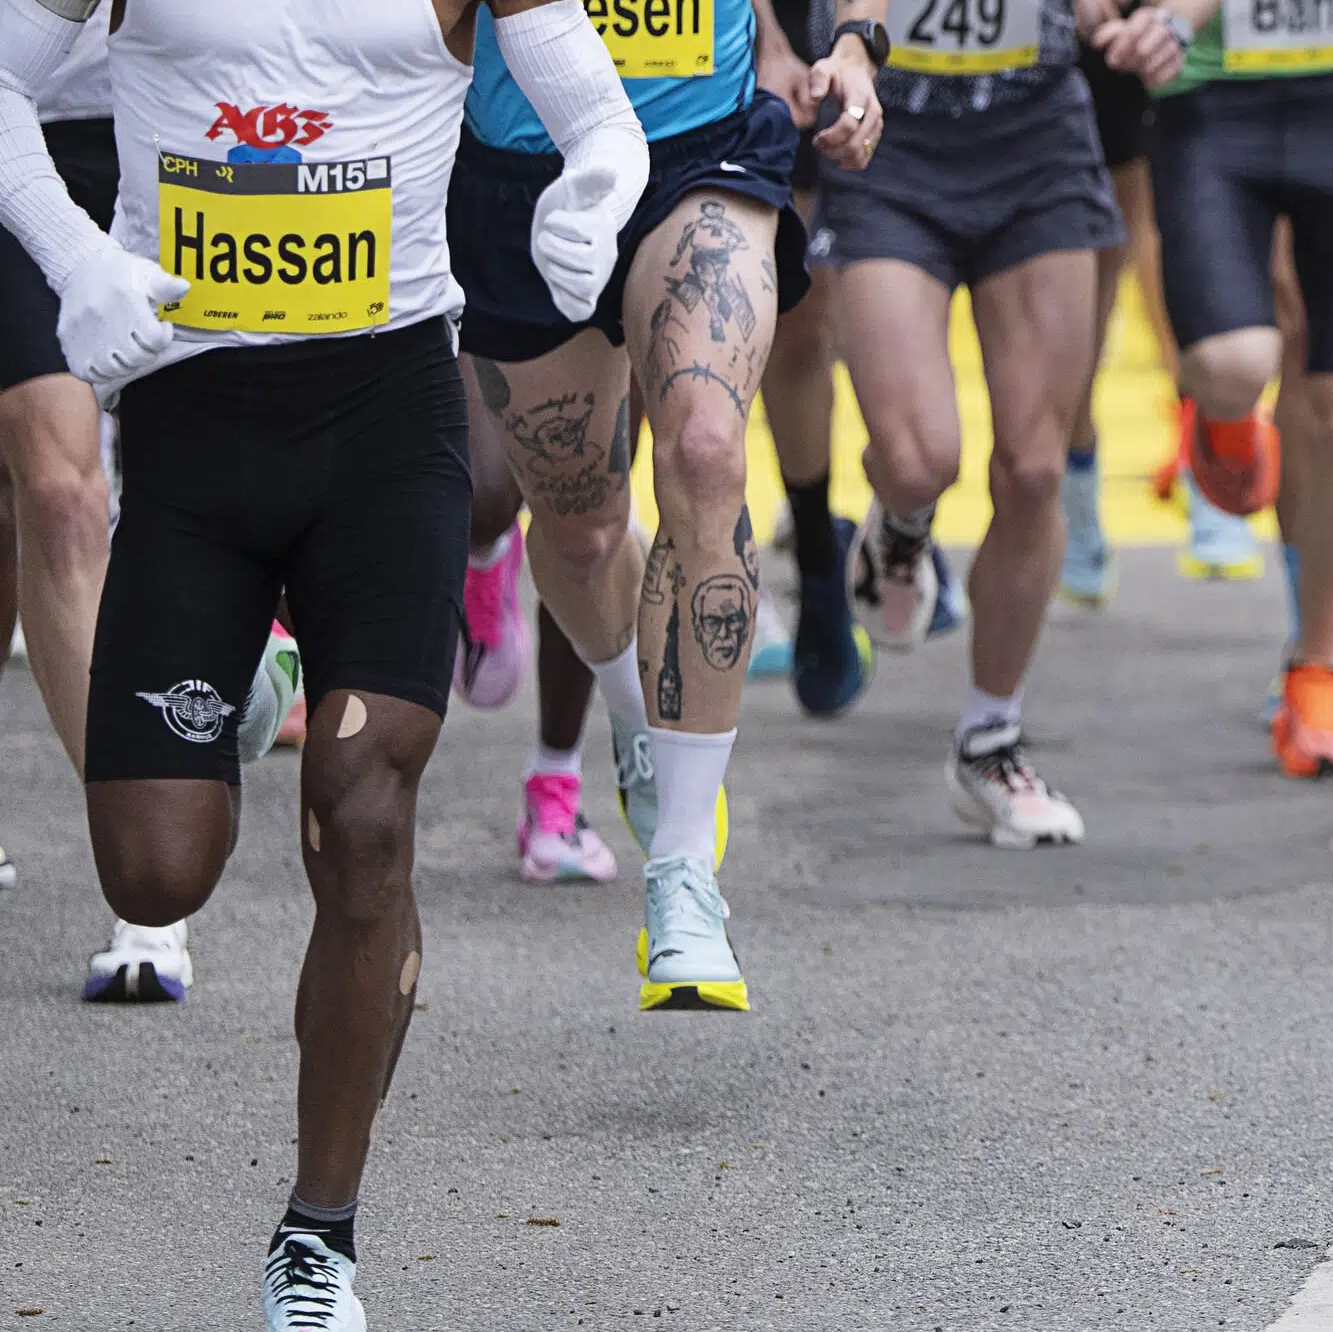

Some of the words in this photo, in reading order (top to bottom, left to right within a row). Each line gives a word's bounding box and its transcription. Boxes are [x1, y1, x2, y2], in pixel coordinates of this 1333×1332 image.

[163, 155, 199, 178] CPH
[297, 162, 366, 193] M15
[174, 206, 377, 285] Hassan
[307, 310, 348, 321] zalando
